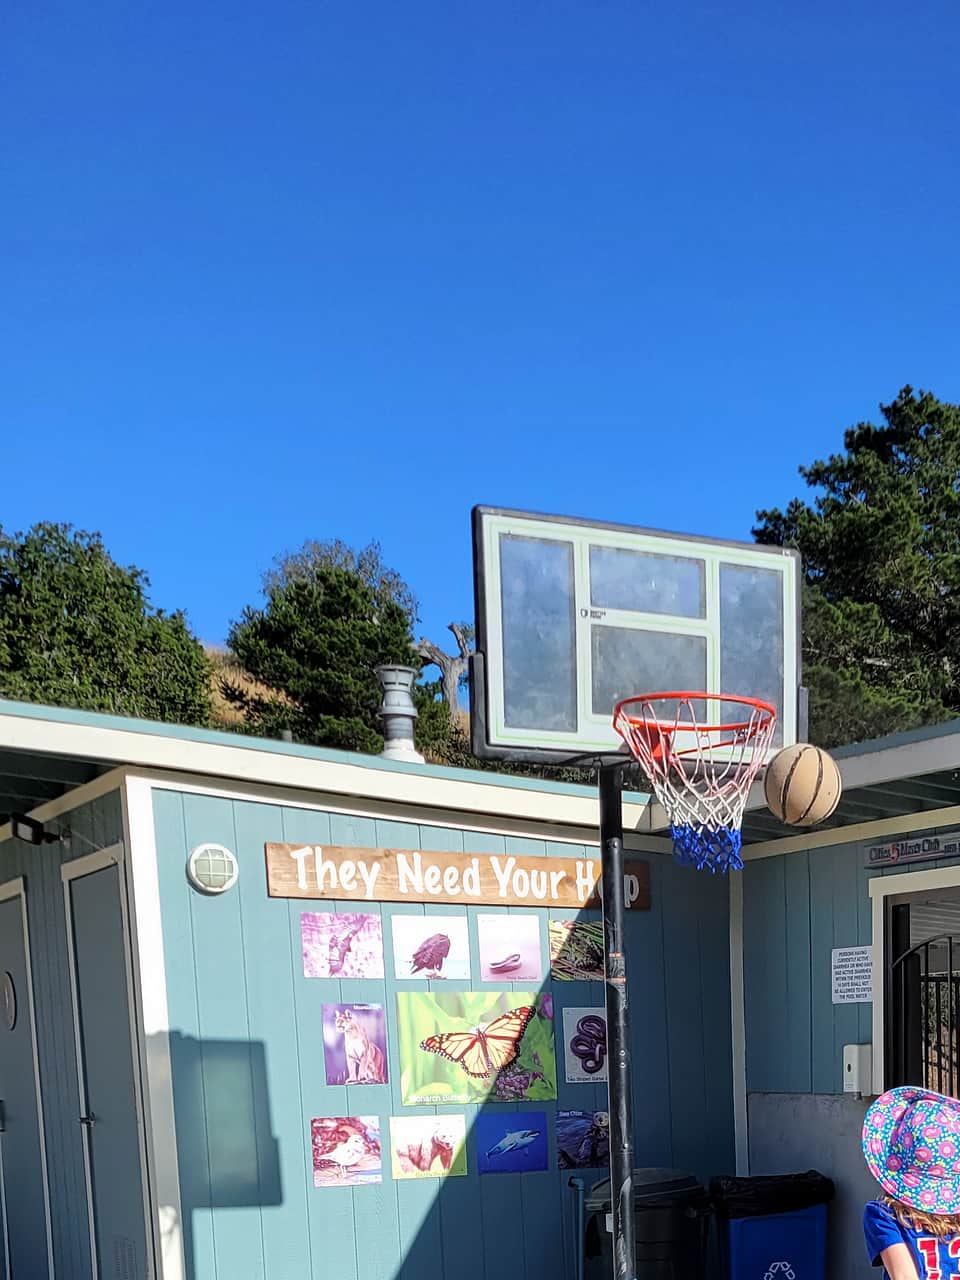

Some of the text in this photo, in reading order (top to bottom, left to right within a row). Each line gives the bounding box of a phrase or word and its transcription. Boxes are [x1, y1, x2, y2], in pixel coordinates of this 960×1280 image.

[290, 845, 640, 908] They Need Your Hp
